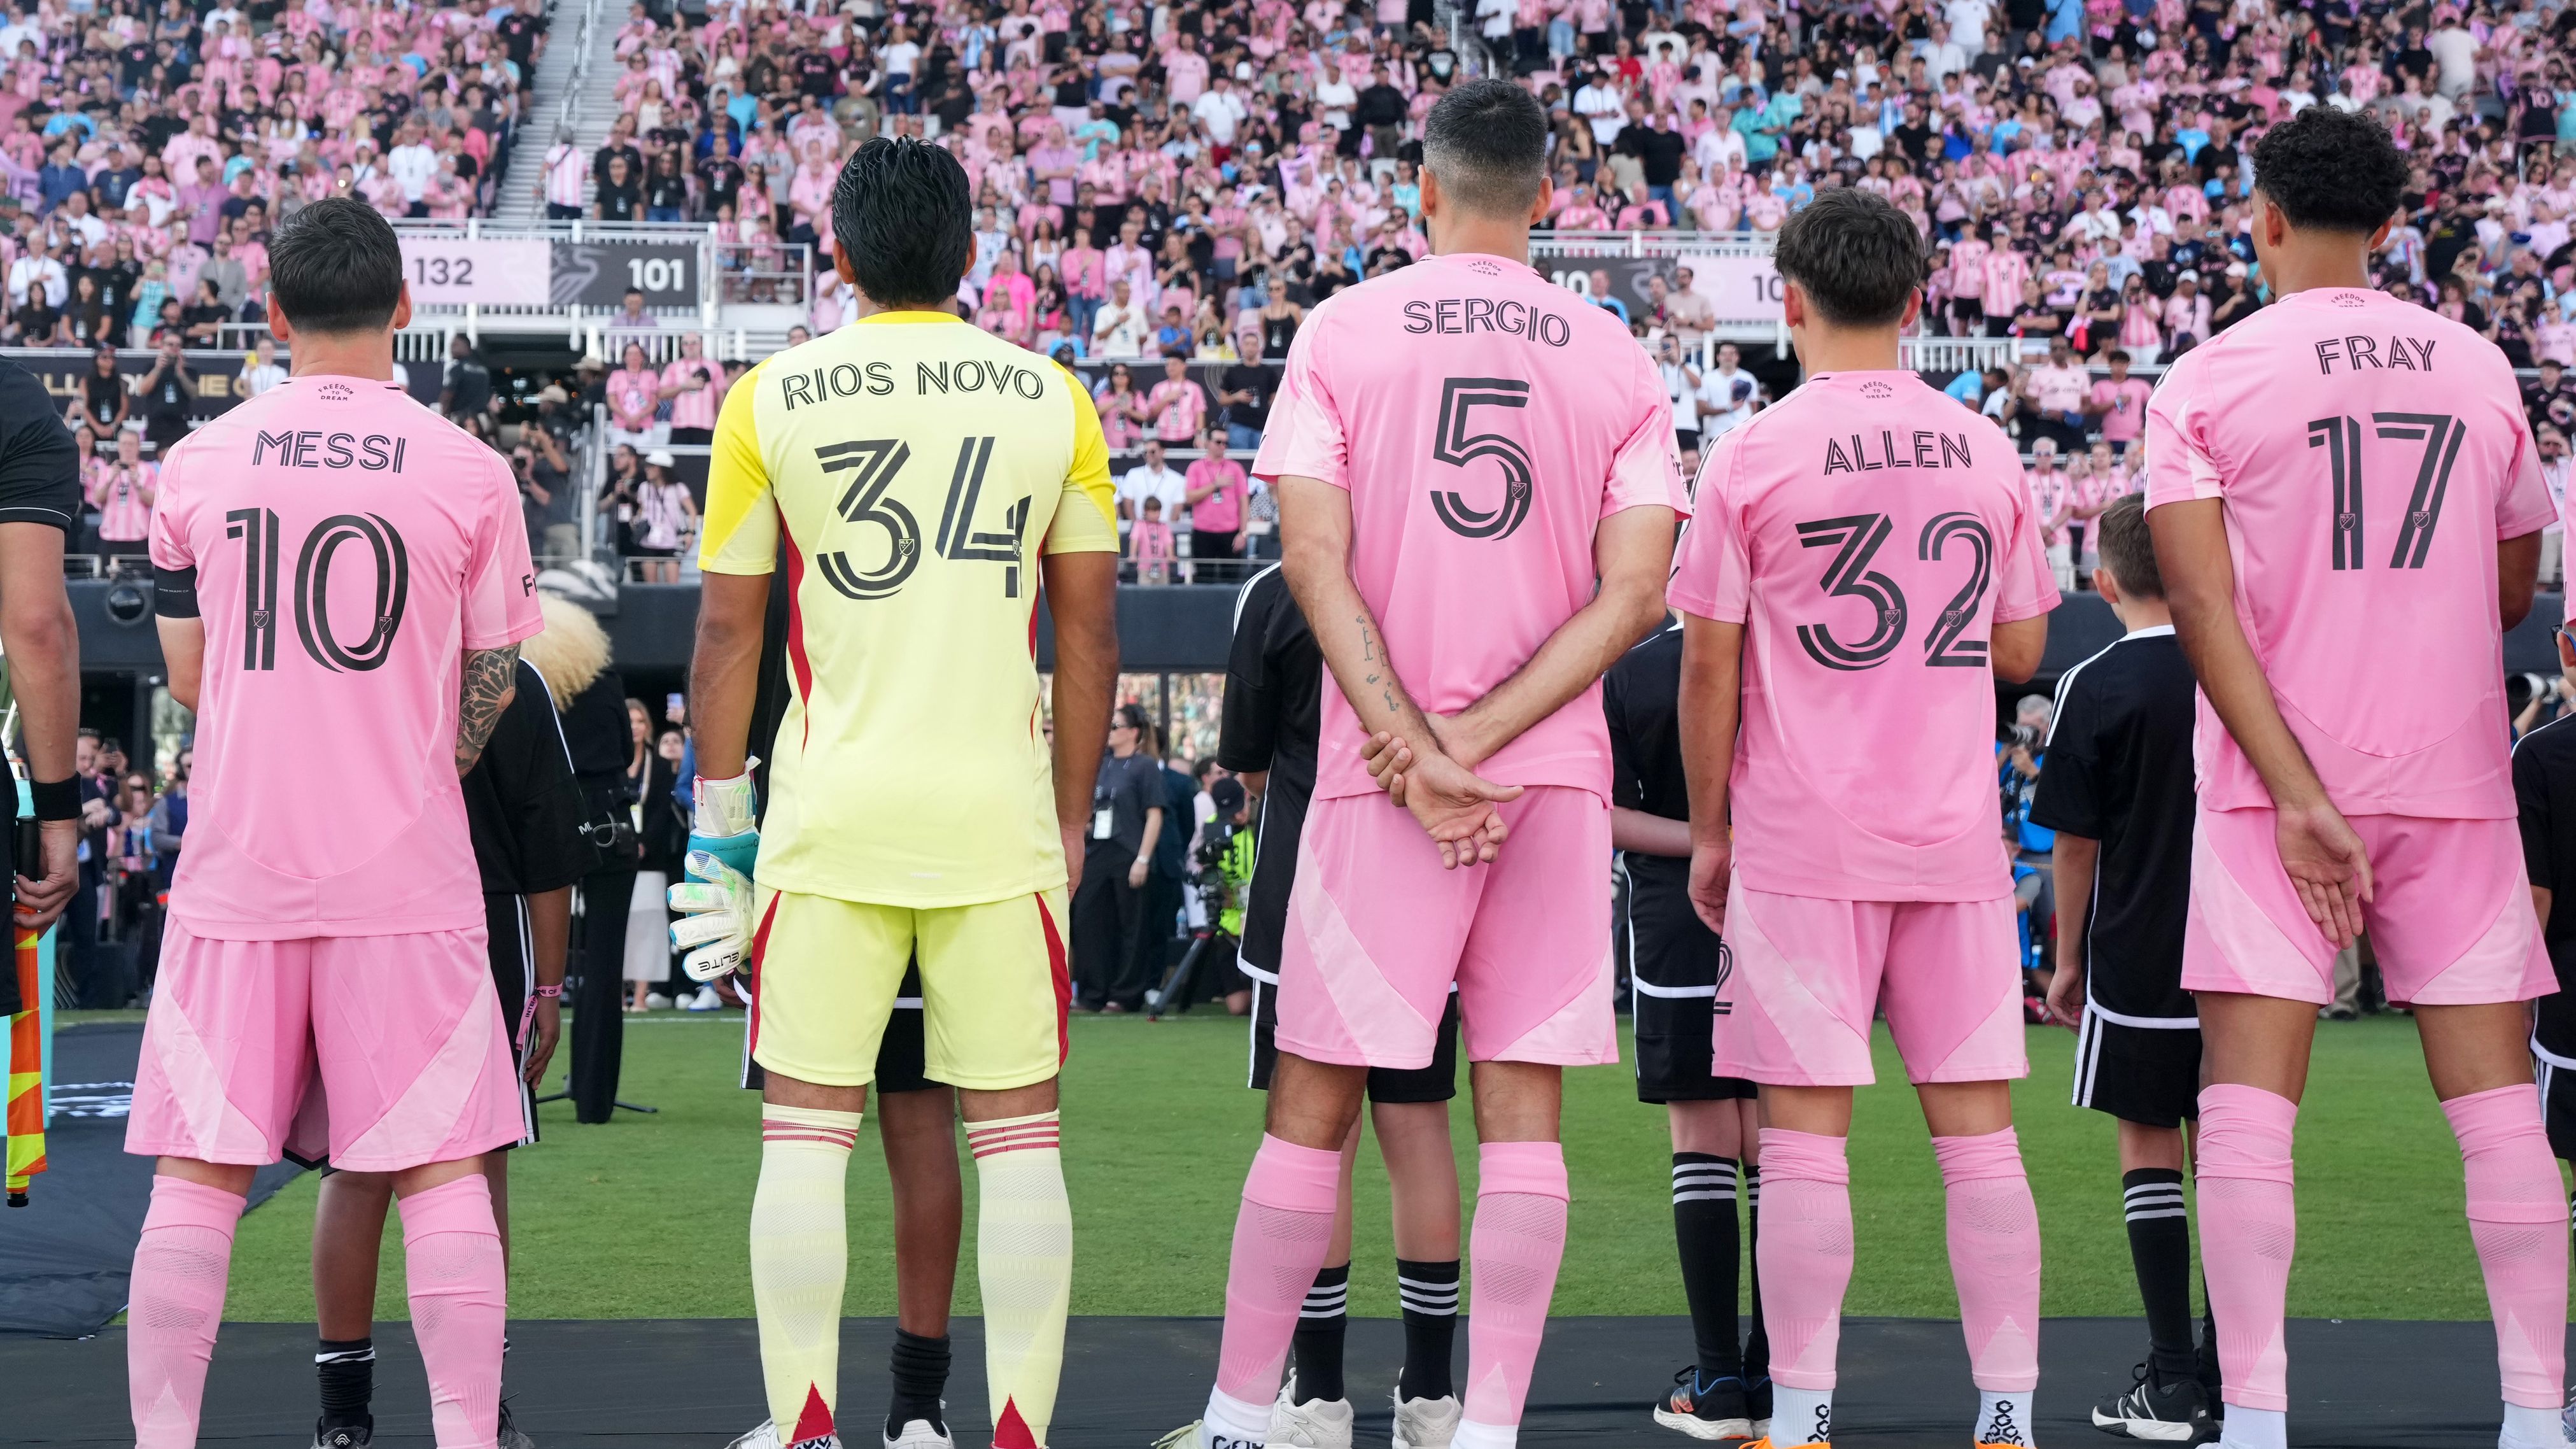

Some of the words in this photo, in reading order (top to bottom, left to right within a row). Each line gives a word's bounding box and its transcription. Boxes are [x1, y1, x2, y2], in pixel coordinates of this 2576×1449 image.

[416, 258, 473, 285] 132
[628, 258, 684, 291] 101
[2331, 293, 2365, 304] FREEDOM
[1404, 299, 1570, 347] SERGIO
[2315, 336, 2436, 375] FRAY
[318, 383, 354, 395] FREEDOM
[782, 362, 894, 411] RIOS
[917, 360, 1044, 400] NOVO
[1859, 381, 1892, 393] FREEDOM
[252, 430, 406, 473] MESSI
[1430, 378, 1533, 541] 5
[1824, 430, 1972, 476] ALLEN
[2308, 412, 2467, 570] 17
[815, 436, 1031, 600] 34
[227, 507, 408, 673] 10
[1795, 512, 1992, 671] 32
[698, 952, 739, 972] ELITE
